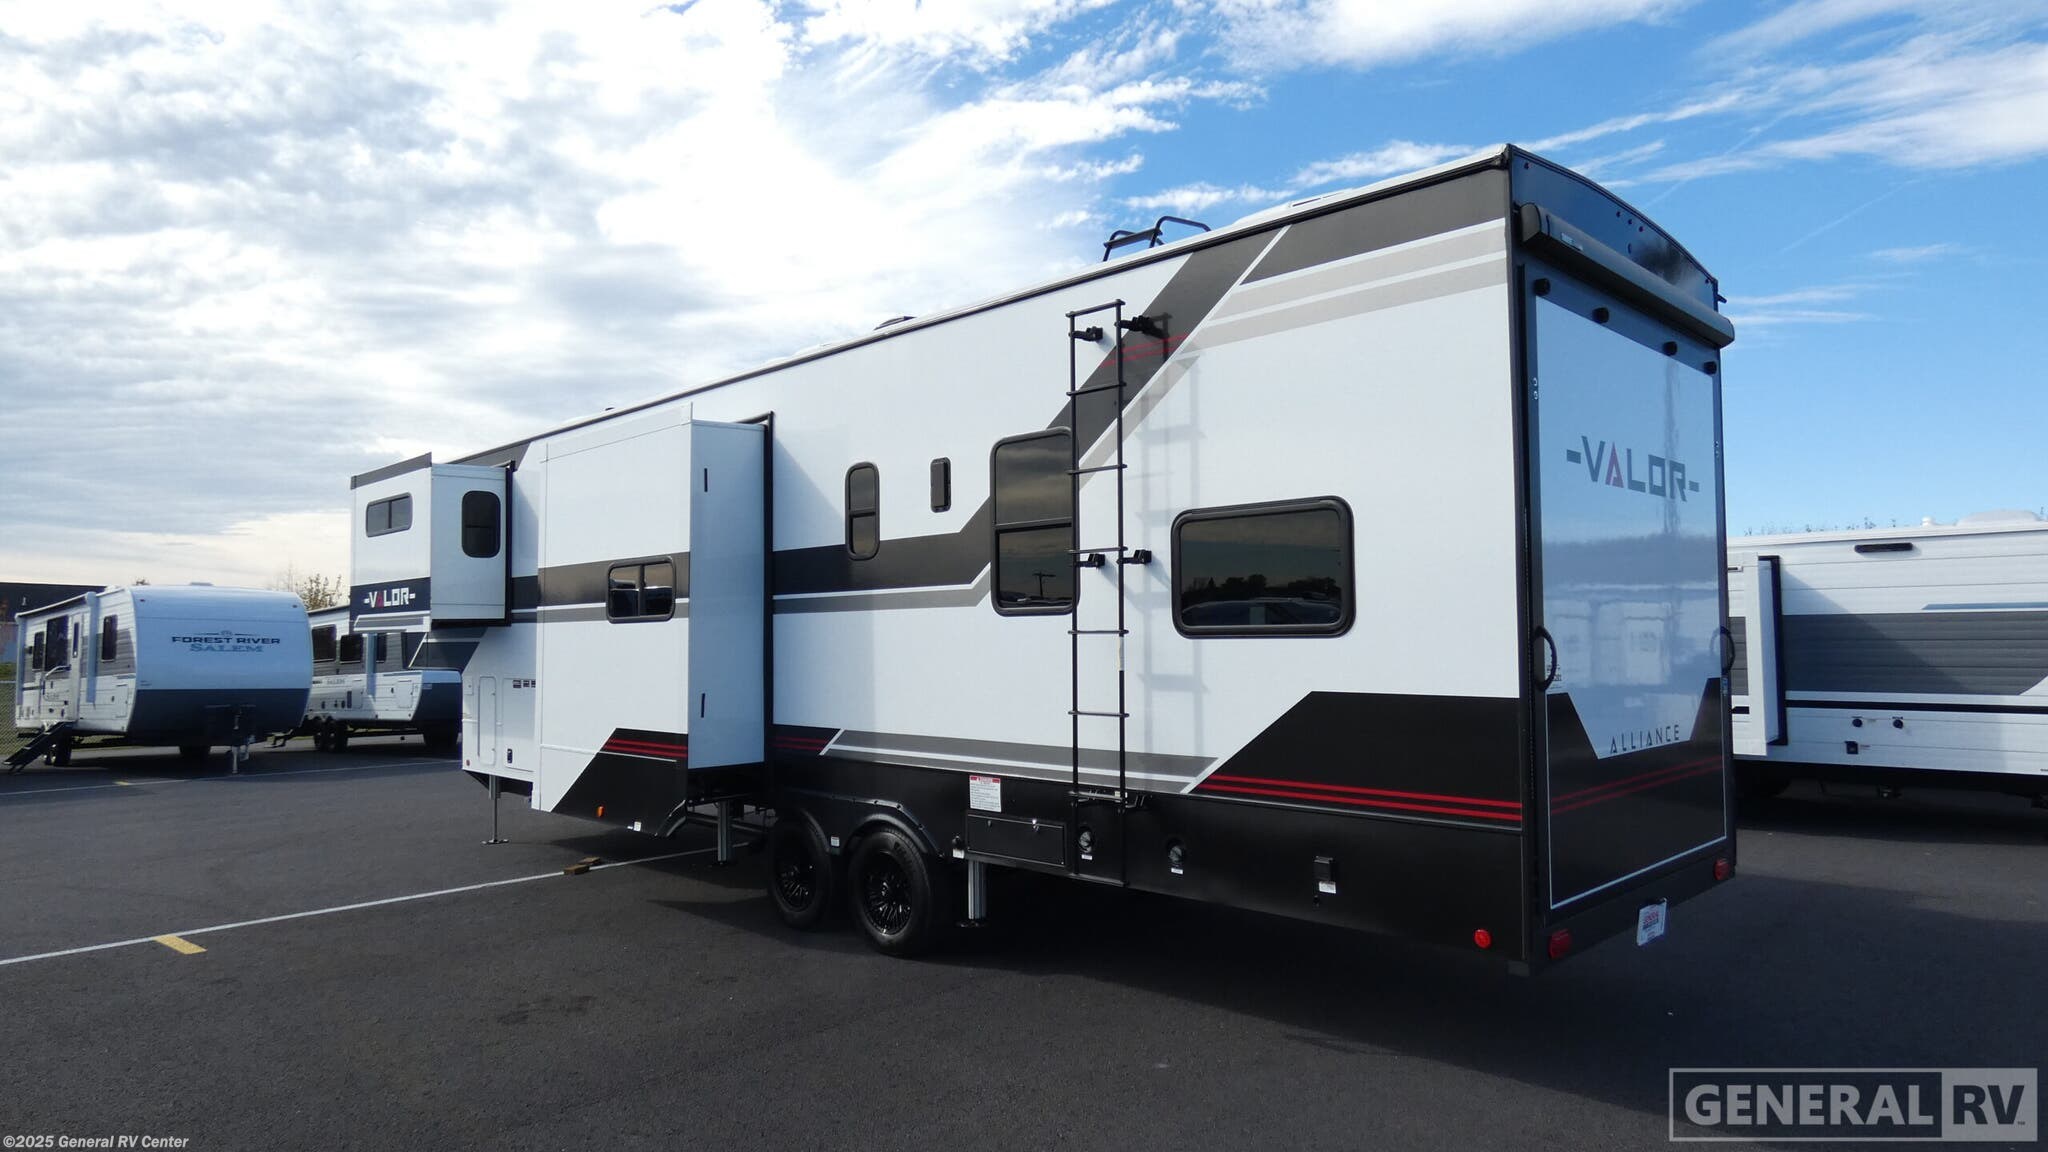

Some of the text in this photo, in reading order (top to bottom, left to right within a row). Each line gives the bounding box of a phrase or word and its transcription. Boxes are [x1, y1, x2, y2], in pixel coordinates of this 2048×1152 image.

[171, 636, 281, 645] FOREST RIVER
[190, 643, 264, 653] SALEM
[1610, 724, 1679, 754] ALLIANCE
